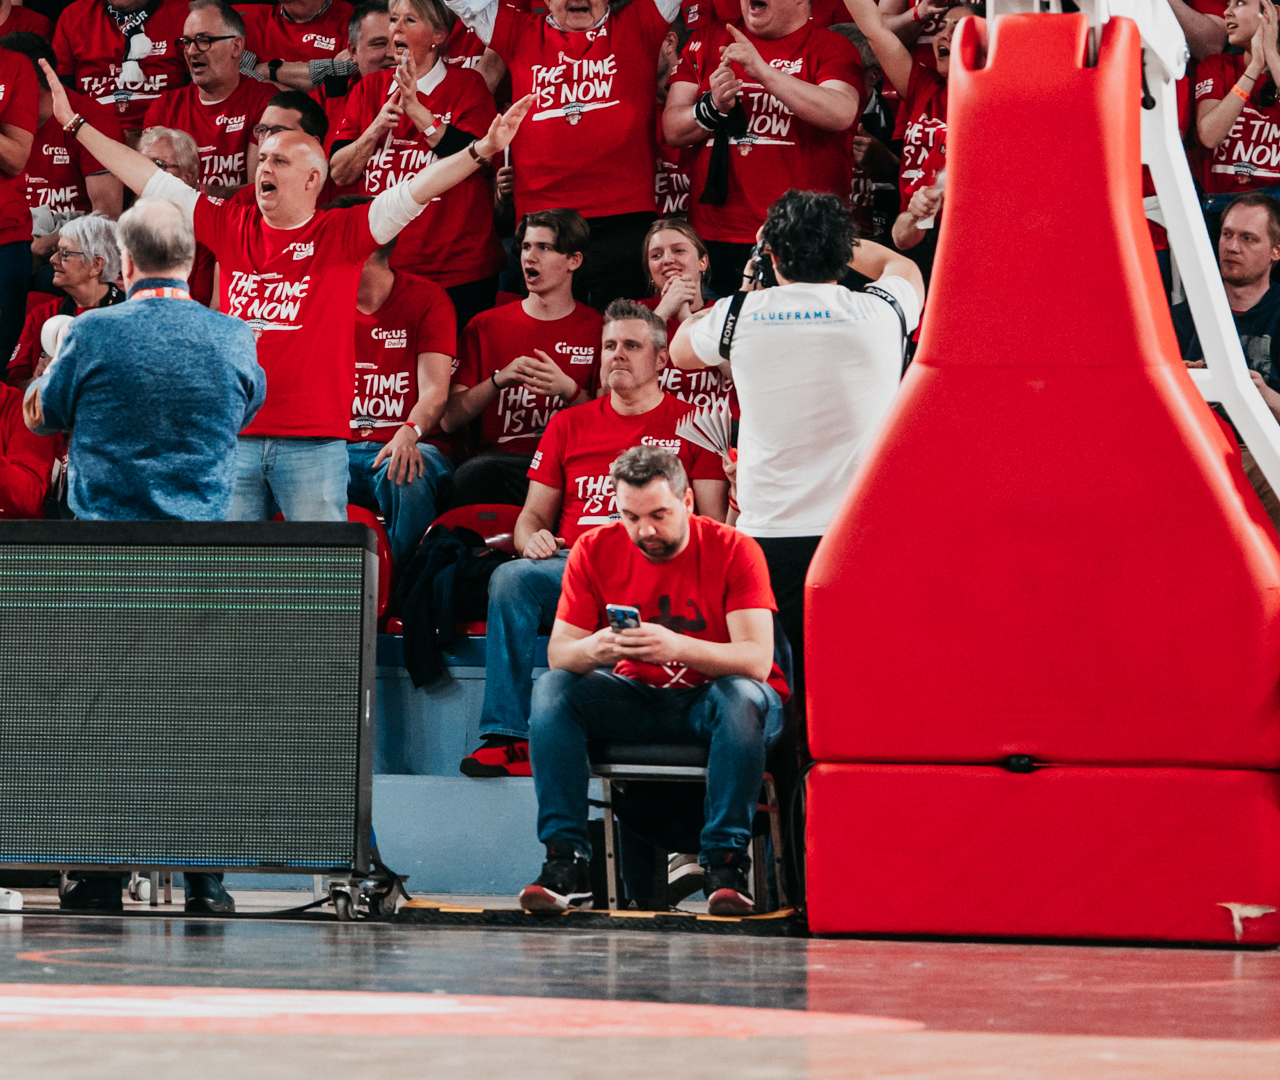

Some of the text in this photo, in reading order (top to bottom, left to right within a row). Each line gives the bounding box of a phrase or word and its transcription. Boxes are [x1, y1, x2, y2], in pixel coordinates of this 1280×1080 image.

[532, 56, 617, 89] THE TIME
[536, 79, 612, 108] IS NOW
[229, 272, 310, 300] THE TIME
[248, 299, 300, 321] NOW
[750, 306, 834, 324] BLUEFRAME
[371, 328, 407, 340] Circus
[723, 314, 738, 348] SONY
[384, 339, 407, 348] Daily
[555, 343, 594, 357] Circus
[364, 372, 409, 396] TIME
[354, 395, 404, 419] NOW
[641, 436, 681, 448] Circus
